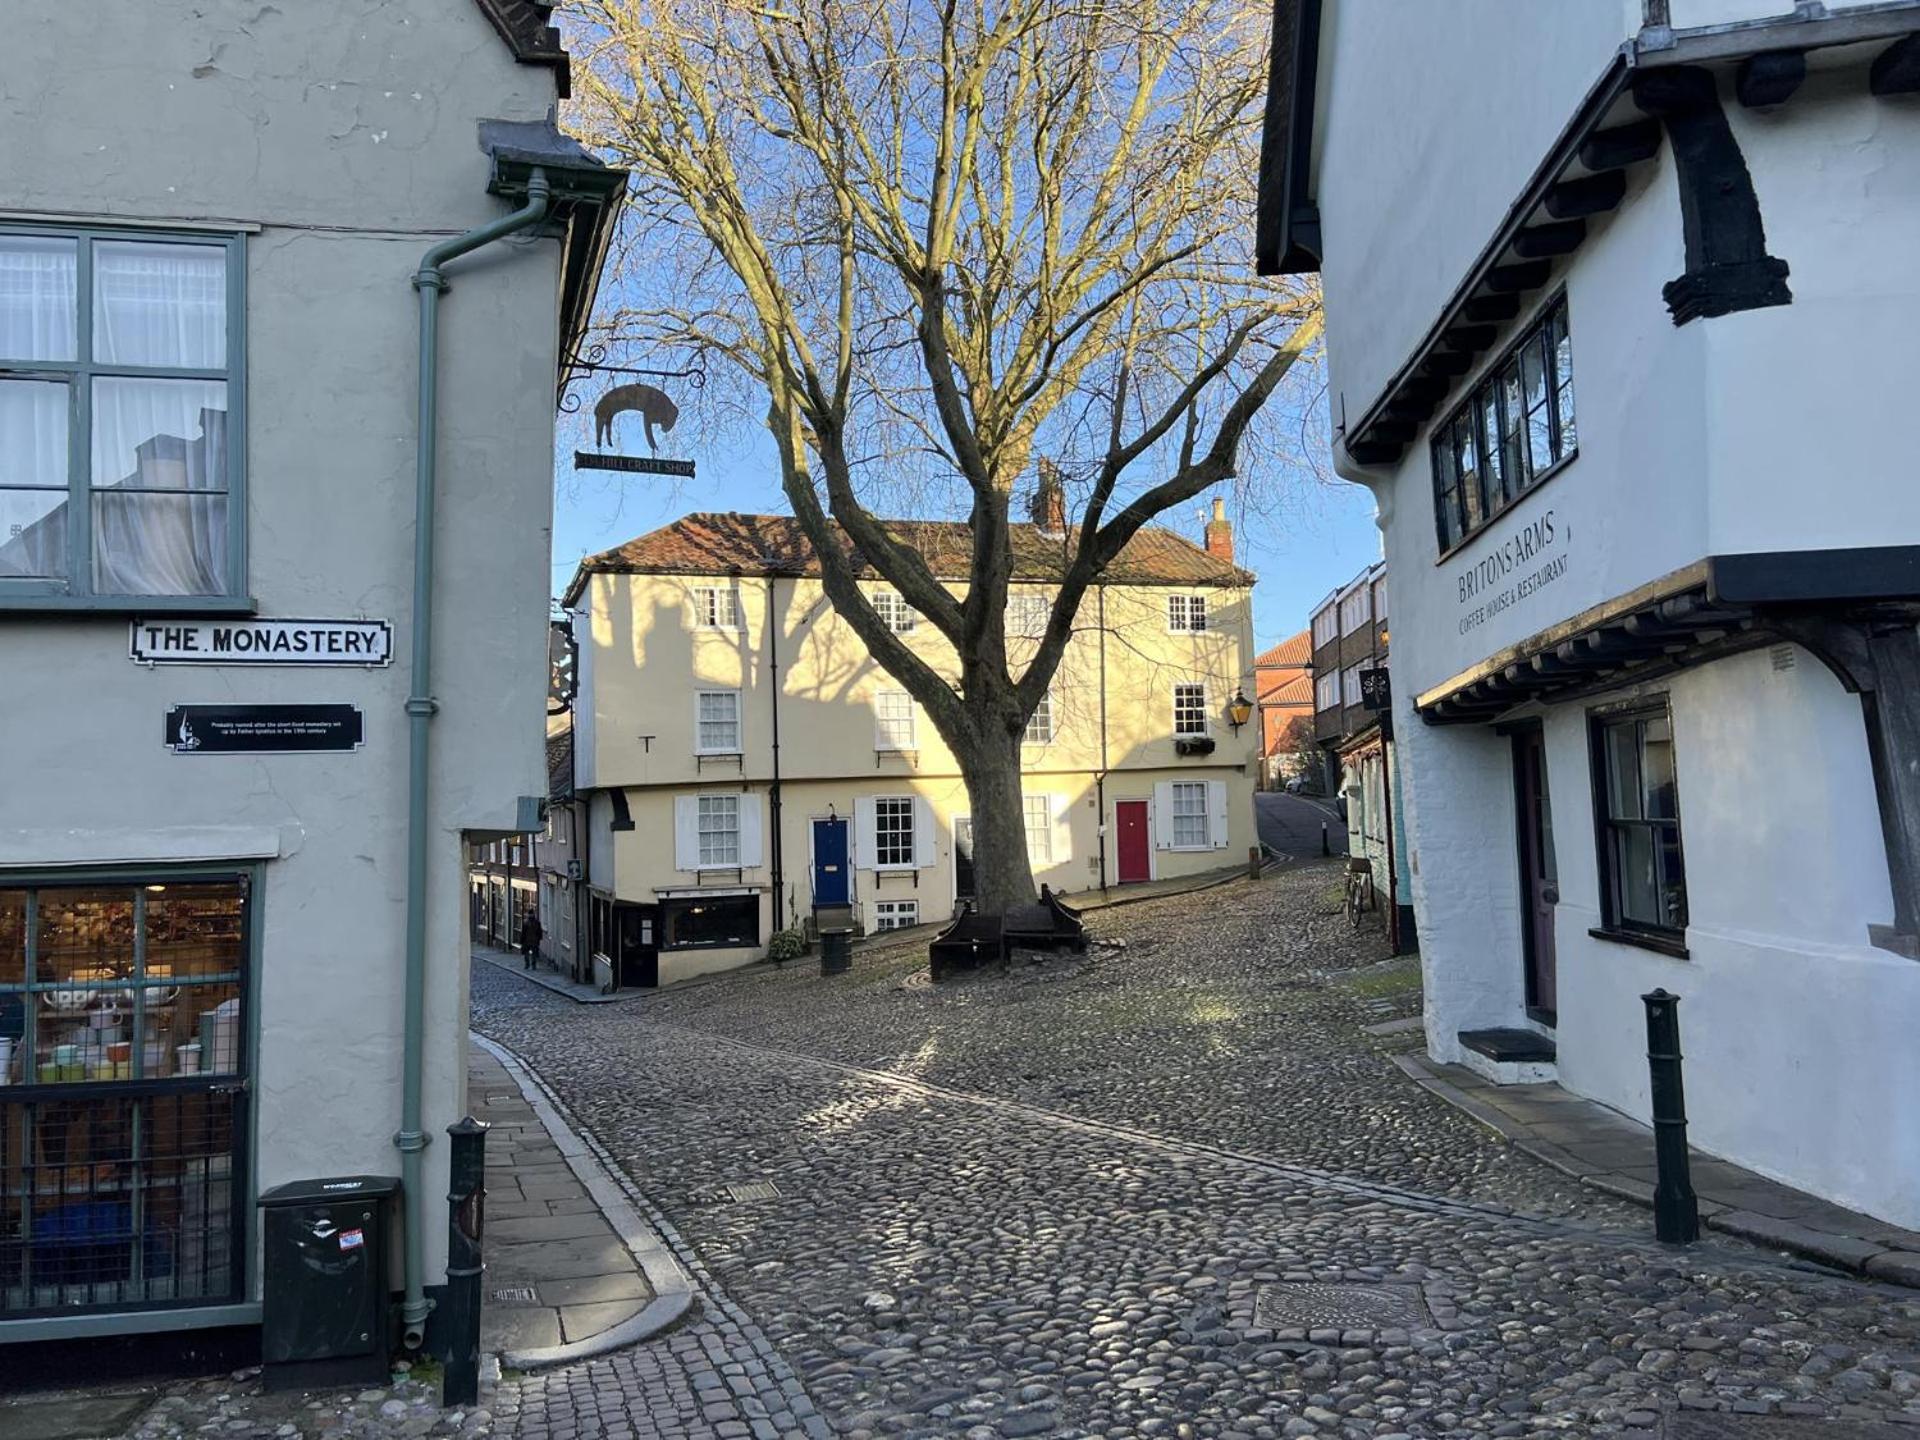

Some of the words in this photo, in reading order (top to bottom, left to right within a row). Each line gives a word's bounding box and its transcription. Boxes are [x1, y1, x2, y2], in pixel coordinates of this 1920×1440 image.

[627, 459, 661, 473] CRAFT
[665, 462, 692, 475] SHOP
[1458, 542, 1513, 603] BRITONS
[1515, 510, 1554, 567] ARMS
[1459, 607, 1485, 635] COFFEE
[1486, 590, 1510, 618] HOUSE
[1517, 553, 1568, 601] RESTAURANT
